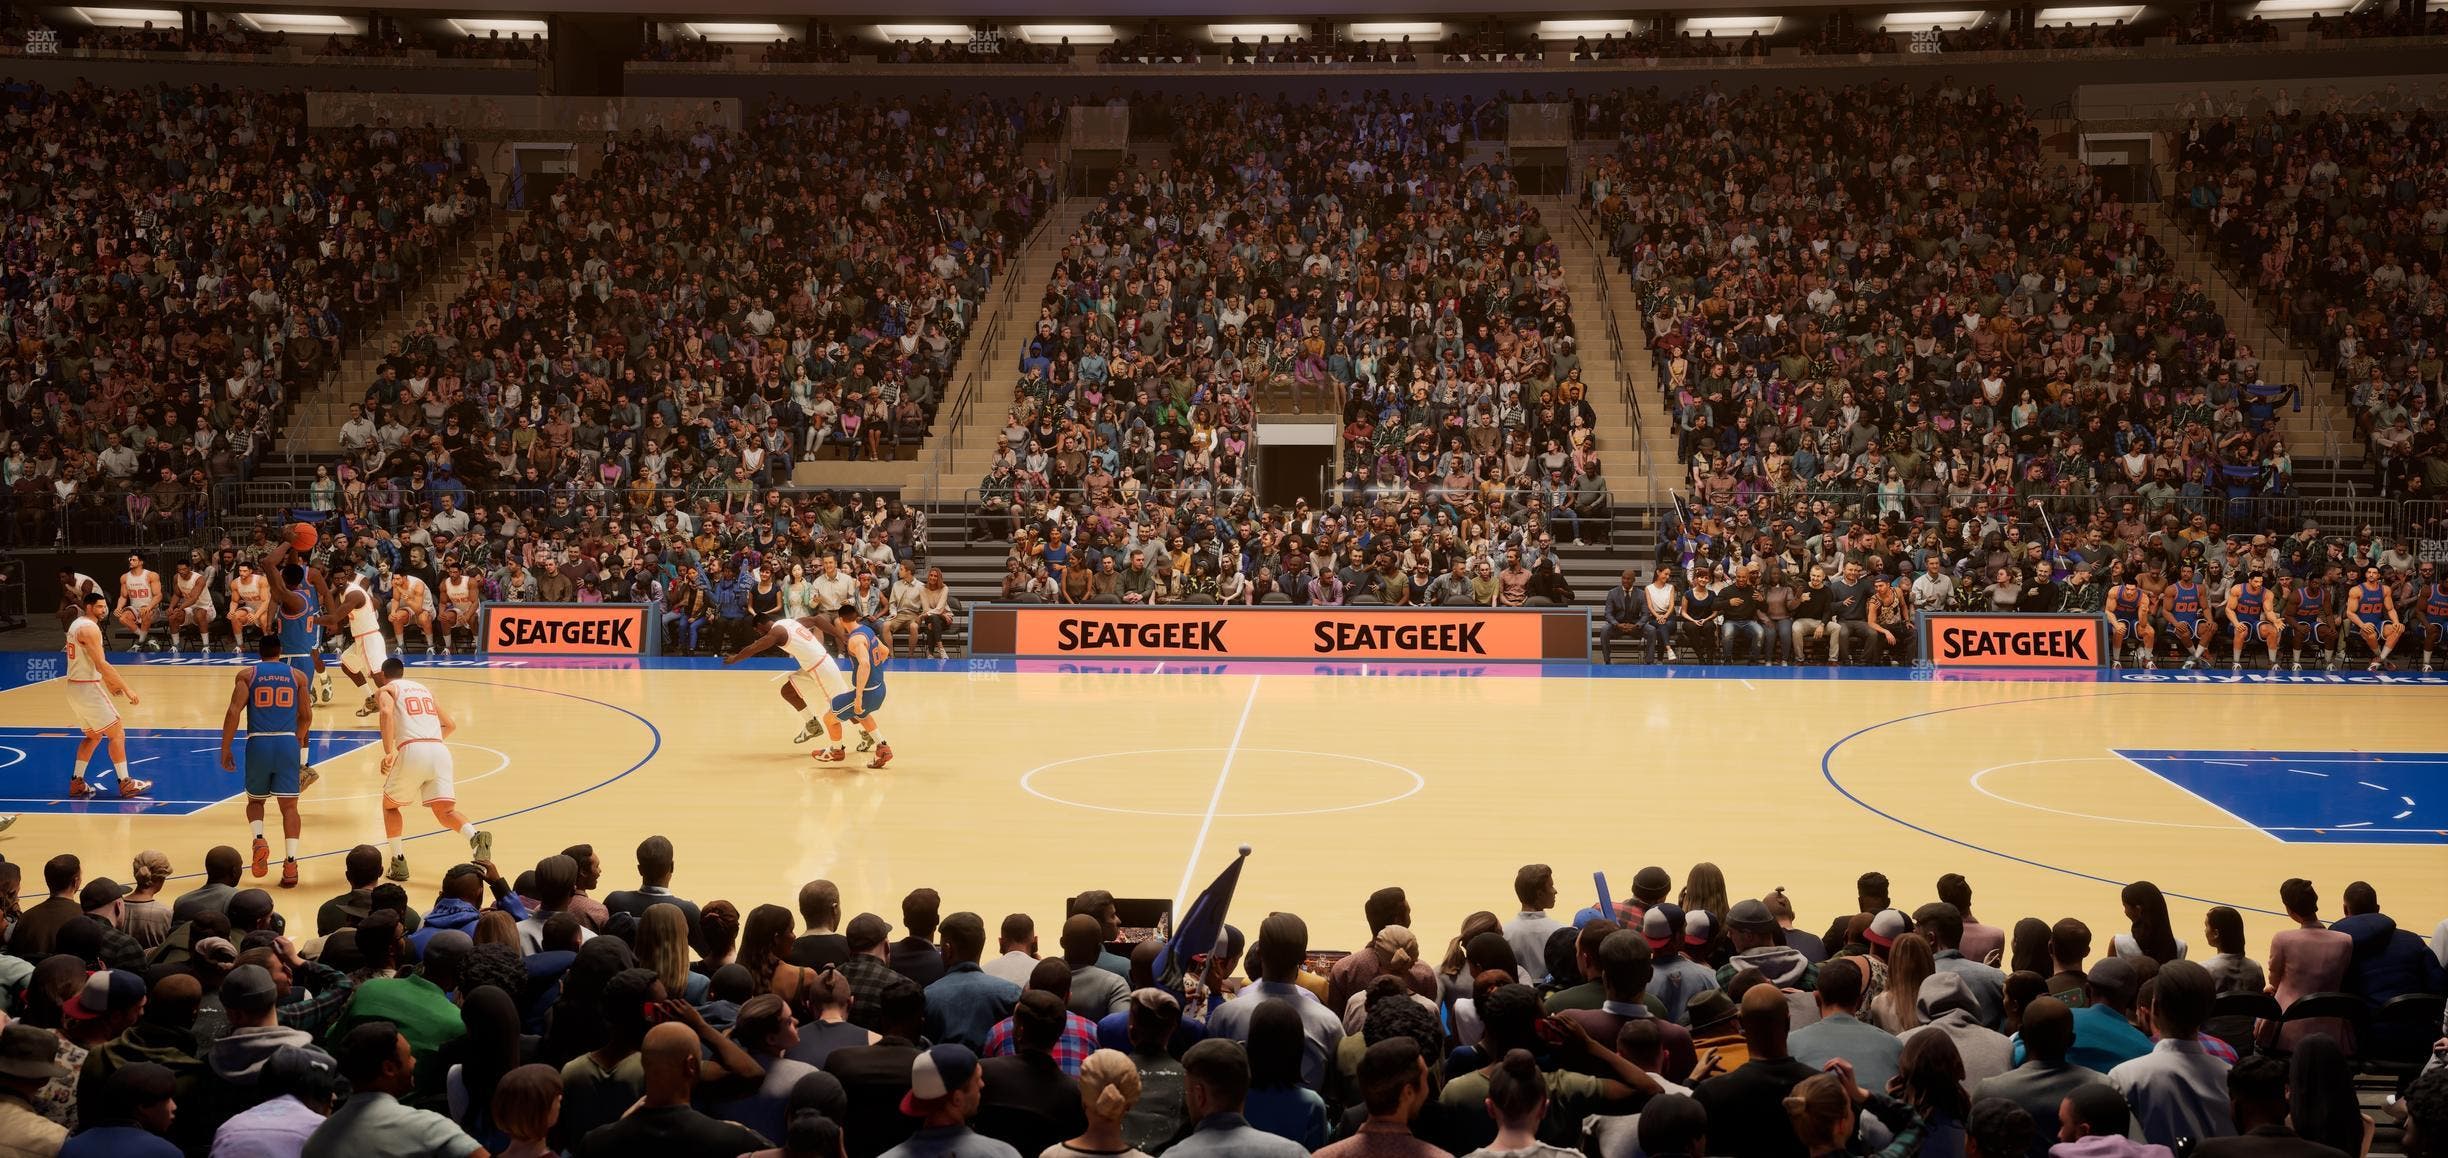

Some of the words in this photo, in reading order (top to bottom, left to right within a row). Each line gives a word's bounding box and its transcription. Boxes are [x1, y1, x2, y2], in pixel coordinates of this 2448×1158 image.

[2175, 601, 2198, 613] 00
[2359, 603, 2384, 614] 00
[498, 617, 634, 648] SEATGEEK
[1058, 619, 1228, 652] SEATGEEK
[1314, 621, 1487, 655] SEATGEEK
[1943, 627, 2090, 660] SEATGEEK
[258, 675, 291, 683] PLAYER
[2121, 673, 2448, 683] @nyknicks
[254, 686, 294, 708] 00
[404, 696, 438, 716] 00
